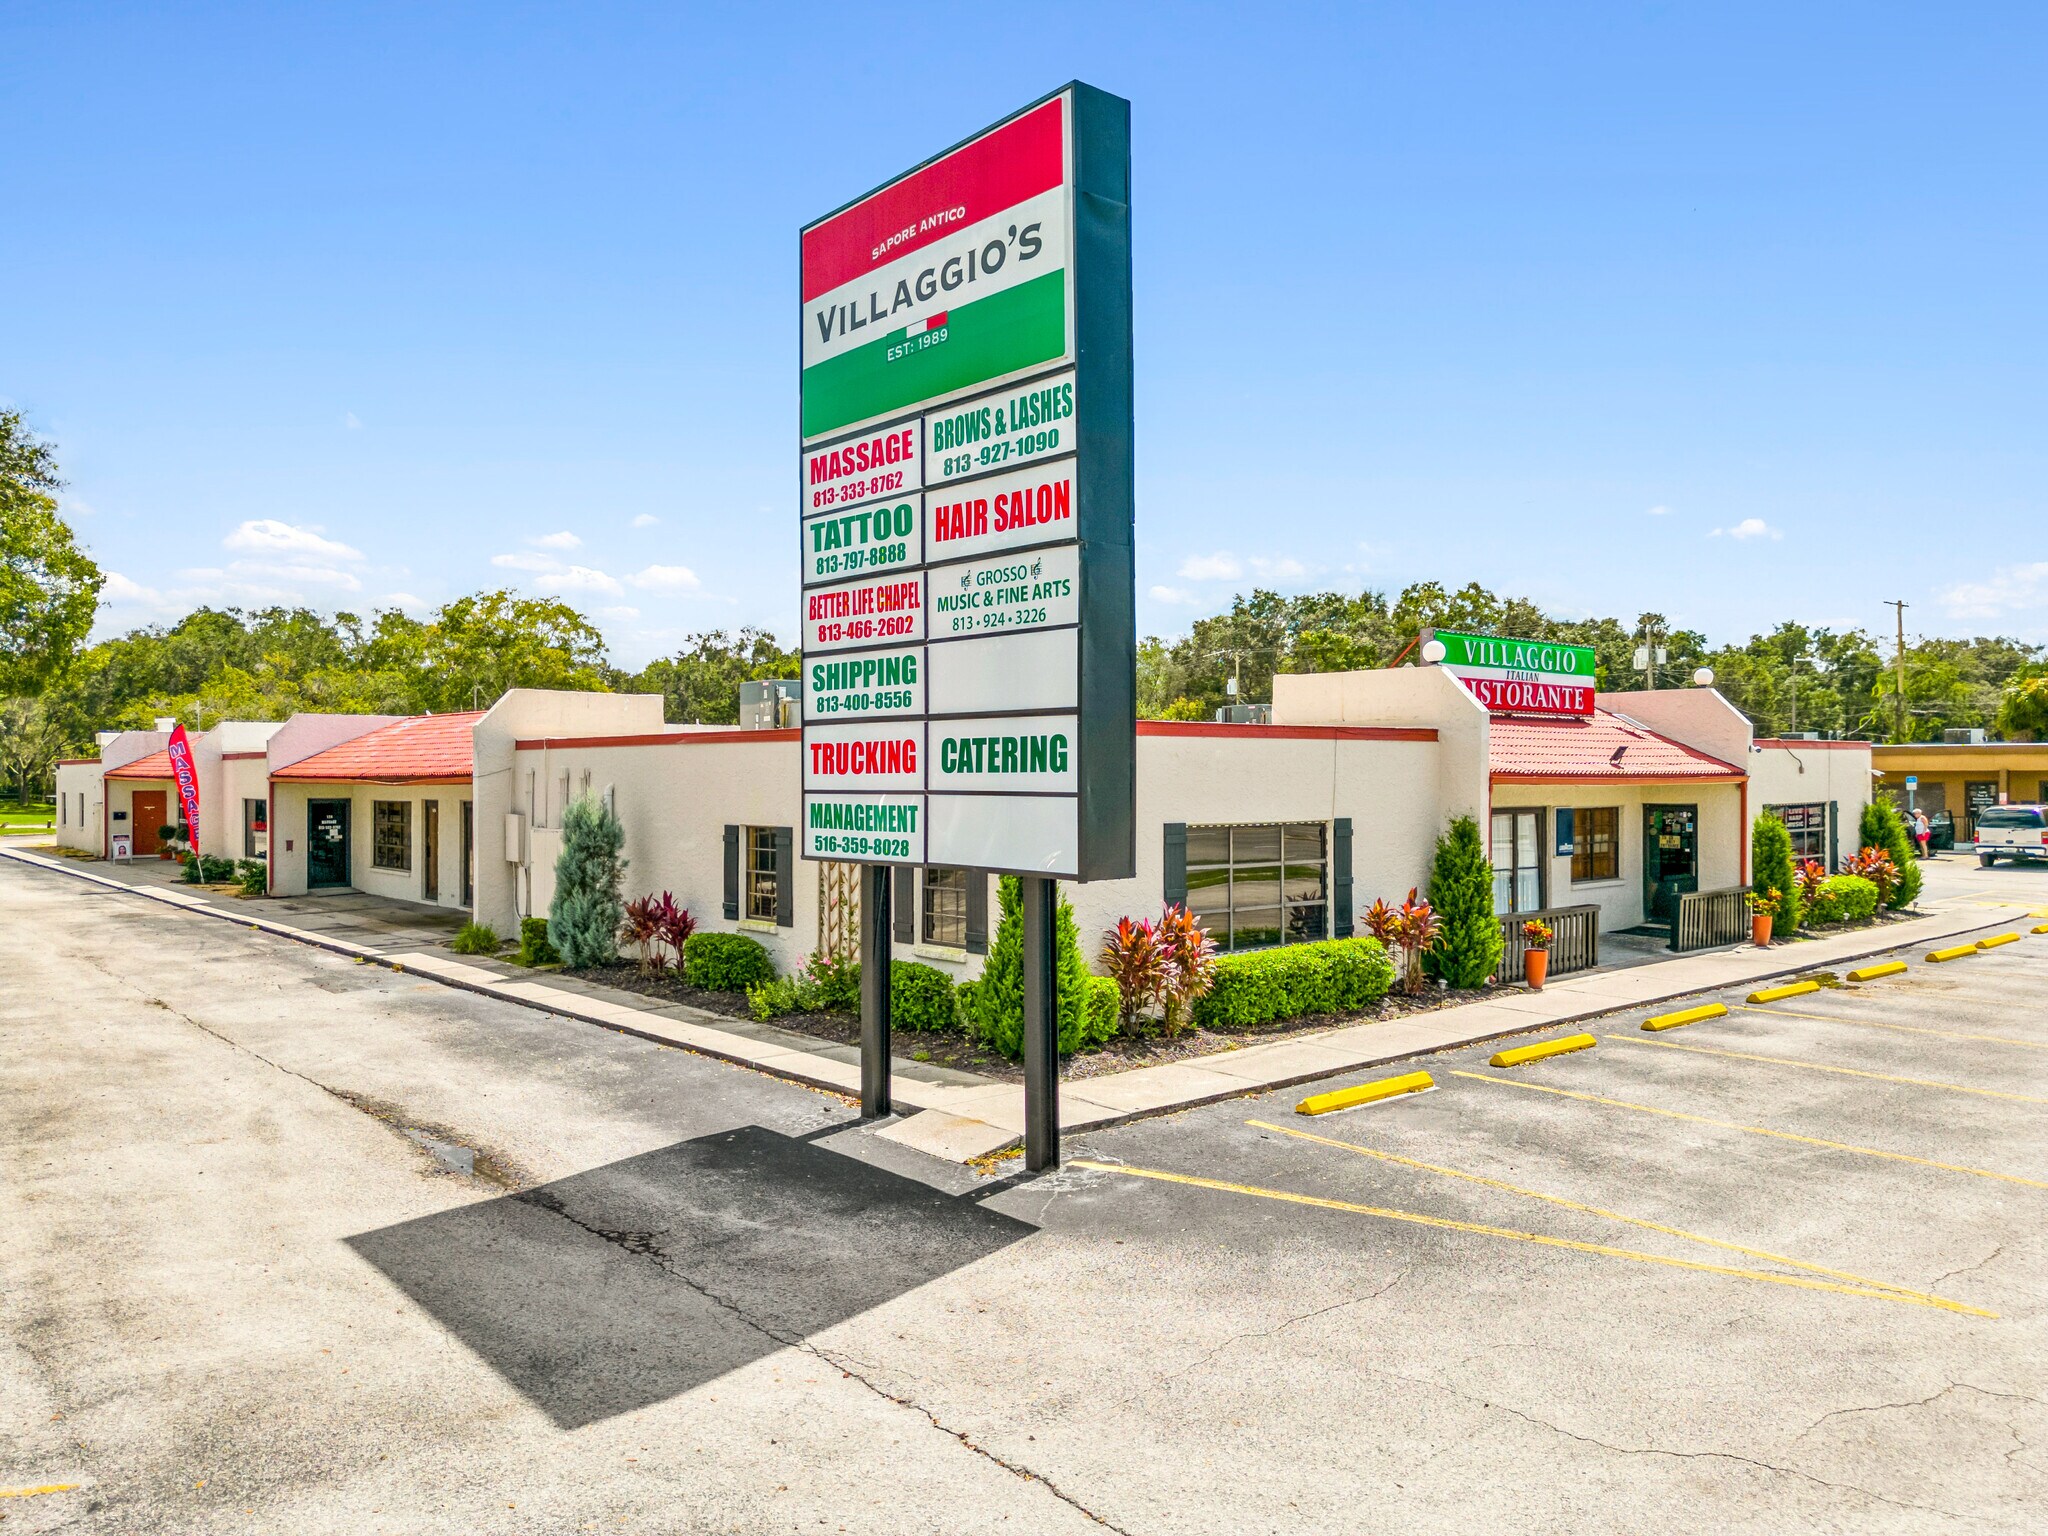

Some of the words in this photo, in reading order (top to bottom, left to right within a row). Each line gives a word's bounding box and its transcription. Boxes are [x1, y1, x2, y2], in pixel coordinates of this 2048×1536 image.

[871, 225, 917, 260] SAPORE
[919, 205, 966, 233] ANTICO
[816, 222, 1042, 344] VILLAGGIO'S
[887, 342, 914, 362] EST:
[918, 328, 948, 350] 1989
[933, 406, 991, 453] BROWS
[995, 409, 1007, 436] &
[1010, 382, 1073, 431] LASHES
[810, 429, 914, 486] MASSAGE
[813, 471, 903, 508] 813-333-8762
[810, 503, 913, 553] TATTOO
[935, 499, 989, 543] HAIR
[994, 479, 1071, 533] SALON
[816, 542, 907, 576] 813-797-8888
[976, 564, 1027, 586] GROSSO
[809, 589, 850, 621] BETTER
[852, 587, 875, 615] LIFE
[876, 581, 921, 612] CHAPEL
[937, 591, 980, 613] MUSIC
[983, 590, 994, 606] &
[996, 585, 1029, 605] FINE
[1032, 579, 1071, 601] ARTS
[818, 615, 914, 643] 813-466-2602
[812, 654, 918, 692] SHIPPING
[1463, 639, 1577, 673] VILLAGGIO
[1506, 670, 1540, 682] ITALIAN
[816, 690, 912, 713] 813-400-8556
[1461, 678, 1584, 710] ISTORANTE
[810, 738, 917, 776] TRUCKING
[941, 733, 1068, 774] CATERING
[810, 803, 918, 833] MANAGEMENT
[815, 835, 910, 857] 516-359-8028
